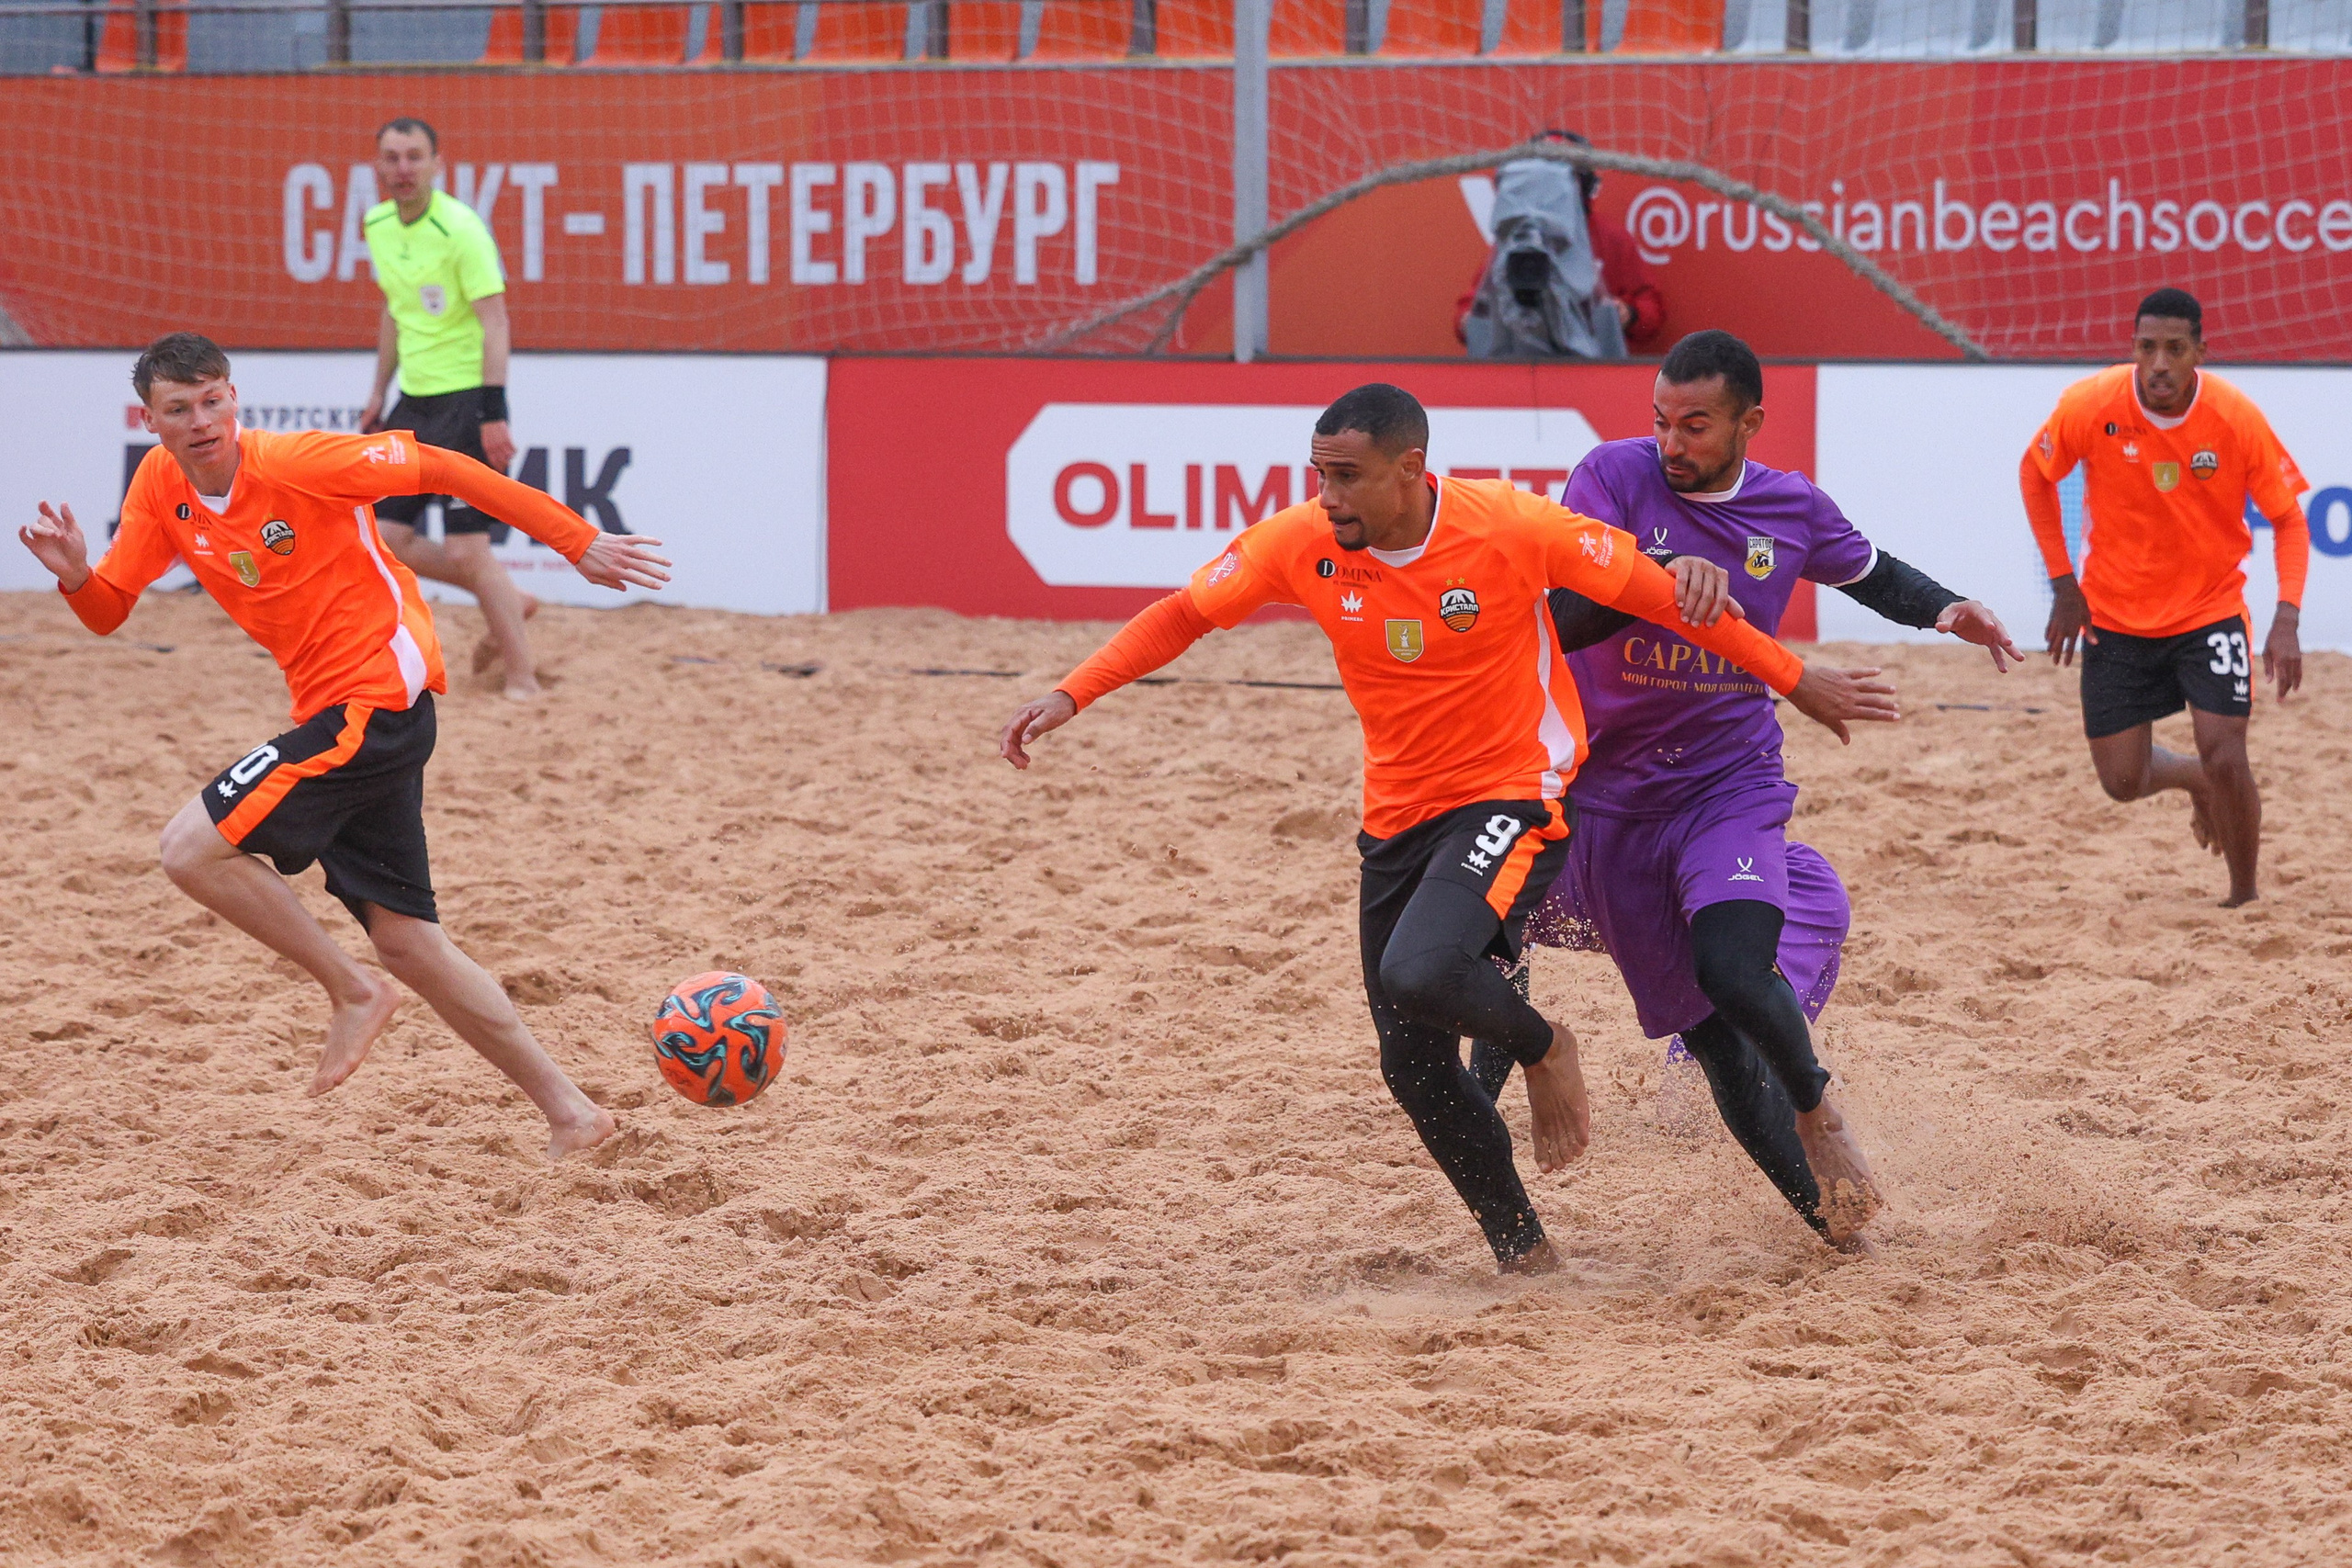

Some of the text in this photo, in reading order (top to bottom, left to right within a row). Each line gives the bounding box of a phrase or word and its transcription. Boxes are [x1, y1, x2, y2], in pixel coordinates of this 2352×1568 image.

[283, 161, 1120, 286] САКТ-ПЕТЕРБУРГ
[1053, 460, 1569, 530] OLIMT
[1440, 603, 1479, 616] КРИСТАЛЛ
[2207, 632, 2249, 677] 33
[1621, 671, 1648, 686] МОЙ
[1650, 677, 1688, 692] ГОРОД
[1693, 682, 1718, 694] МОЯ
[1475, 814, 1521, 856] 9
[1727, 873, 1764, 882] JÖGEL
